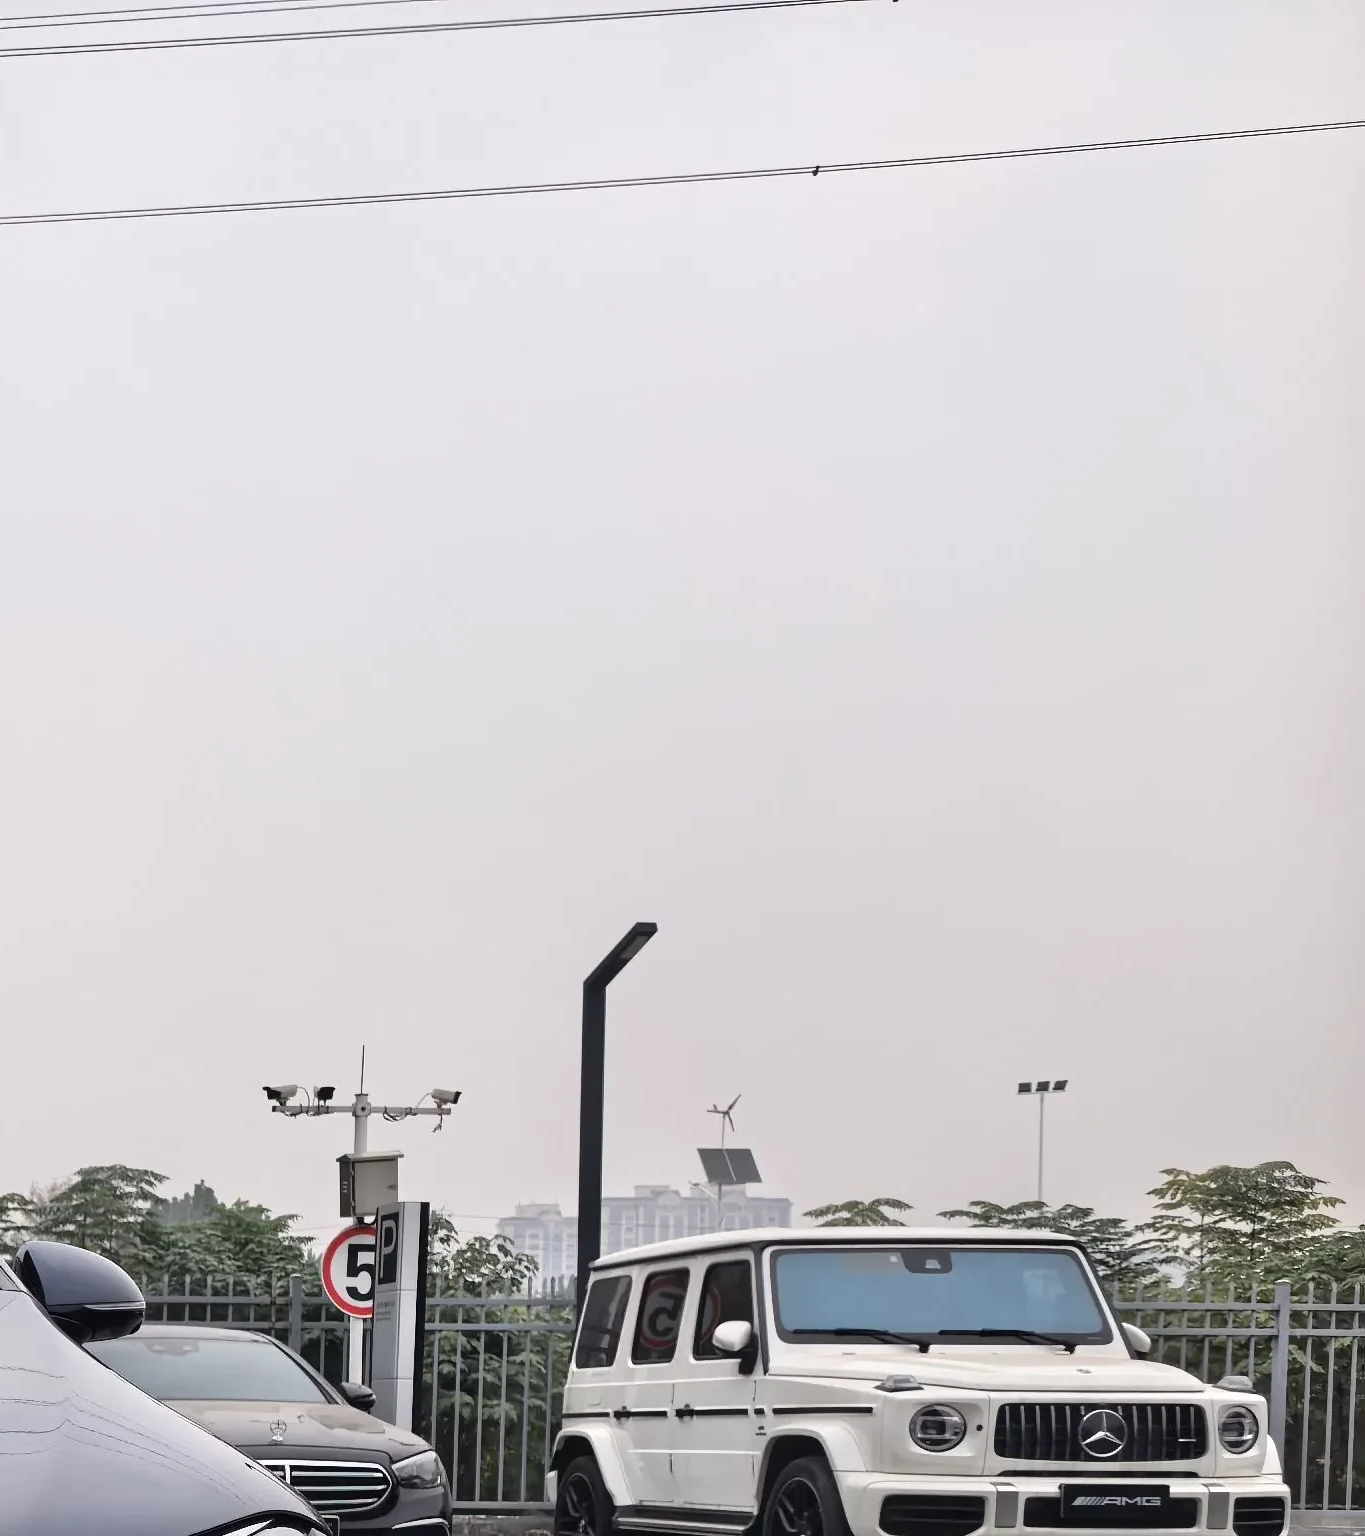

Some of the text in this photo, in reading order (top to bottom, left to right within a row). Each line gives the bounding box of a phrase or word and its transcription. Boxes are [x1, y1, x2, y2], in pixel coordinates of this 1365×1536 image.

[346, 1243, 376, 1302] 5
[379, 1219, 397, 1279] P
[1102, 1496, 1162, 1506] AMG
